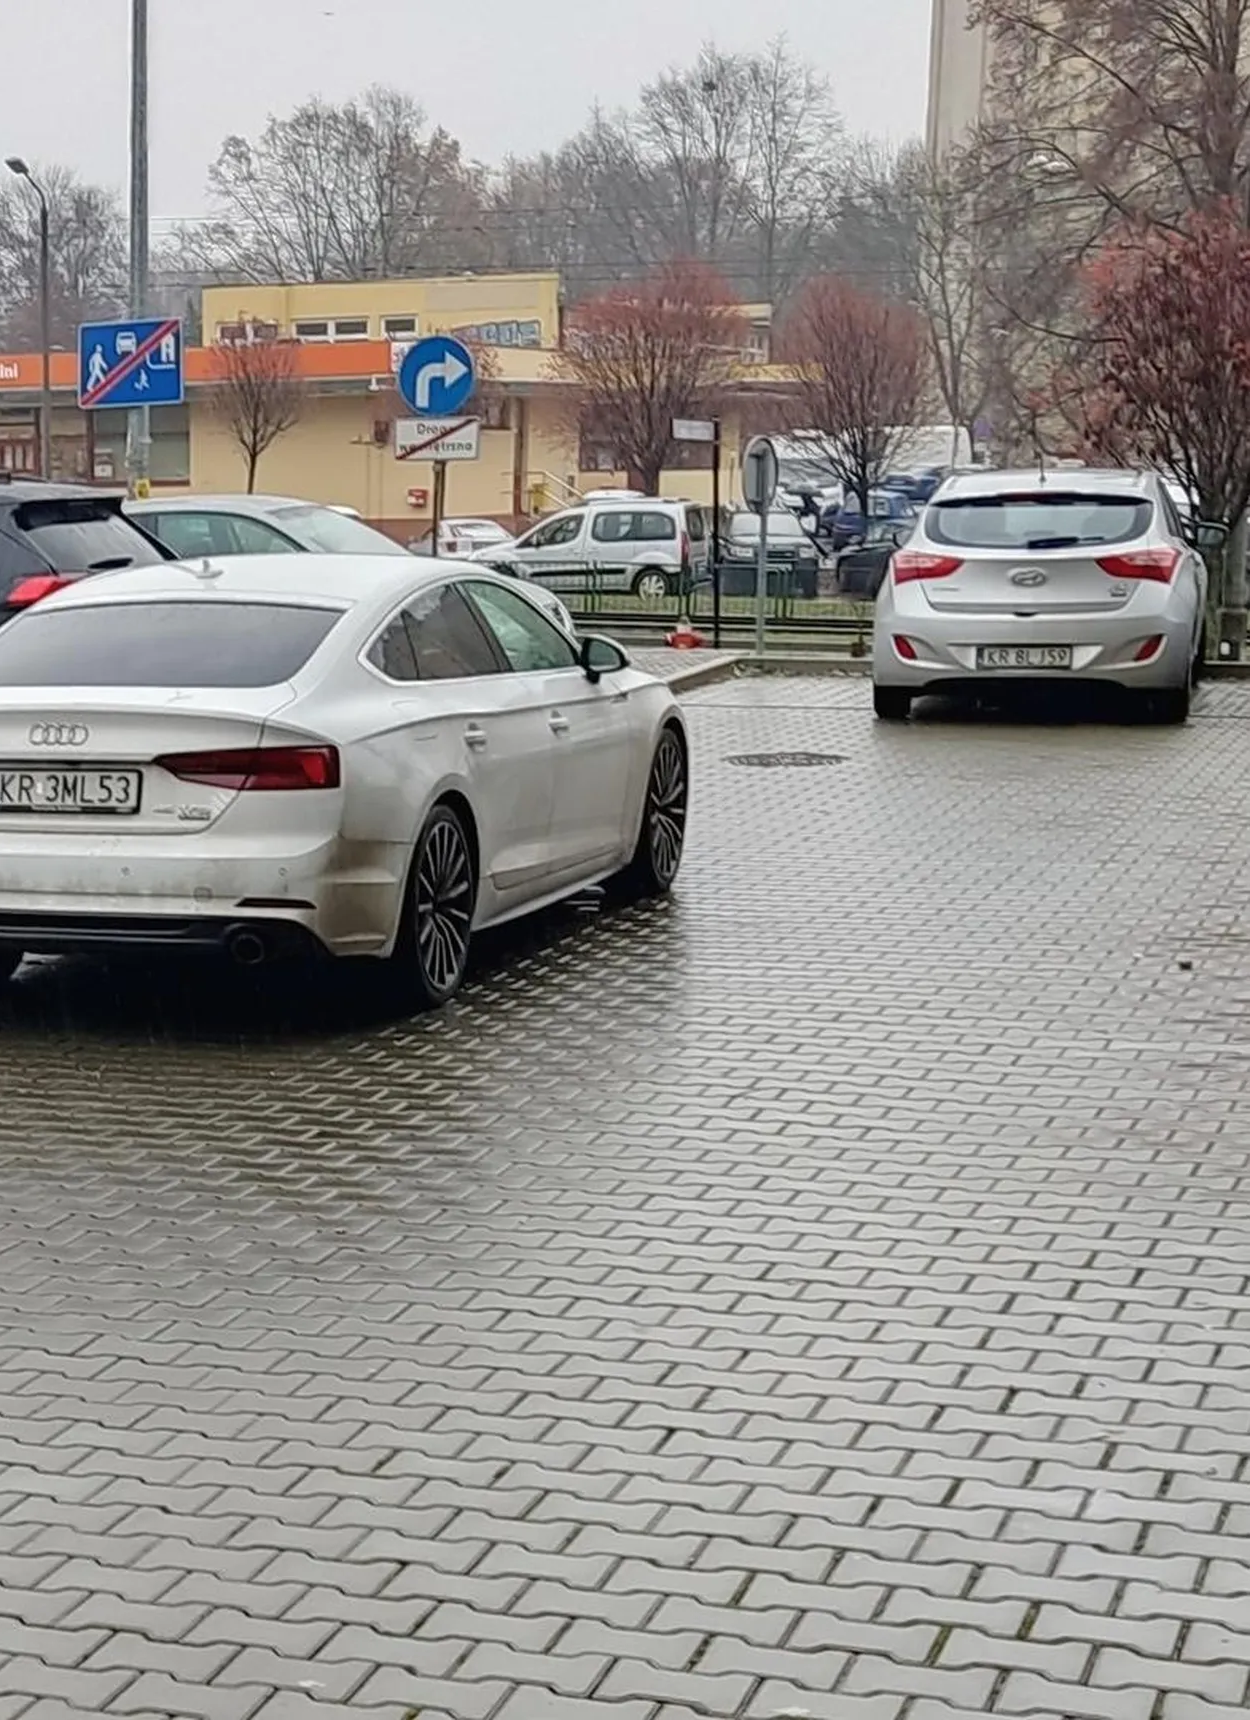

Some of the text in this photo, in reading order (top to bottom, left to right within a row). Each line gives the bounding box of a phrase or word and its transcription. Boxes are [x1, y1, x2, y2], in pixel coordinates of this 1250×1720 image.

[987, 648, 1067, 665] KR 8LJ59
[0, 773, 130, 804] KR 3ML53
